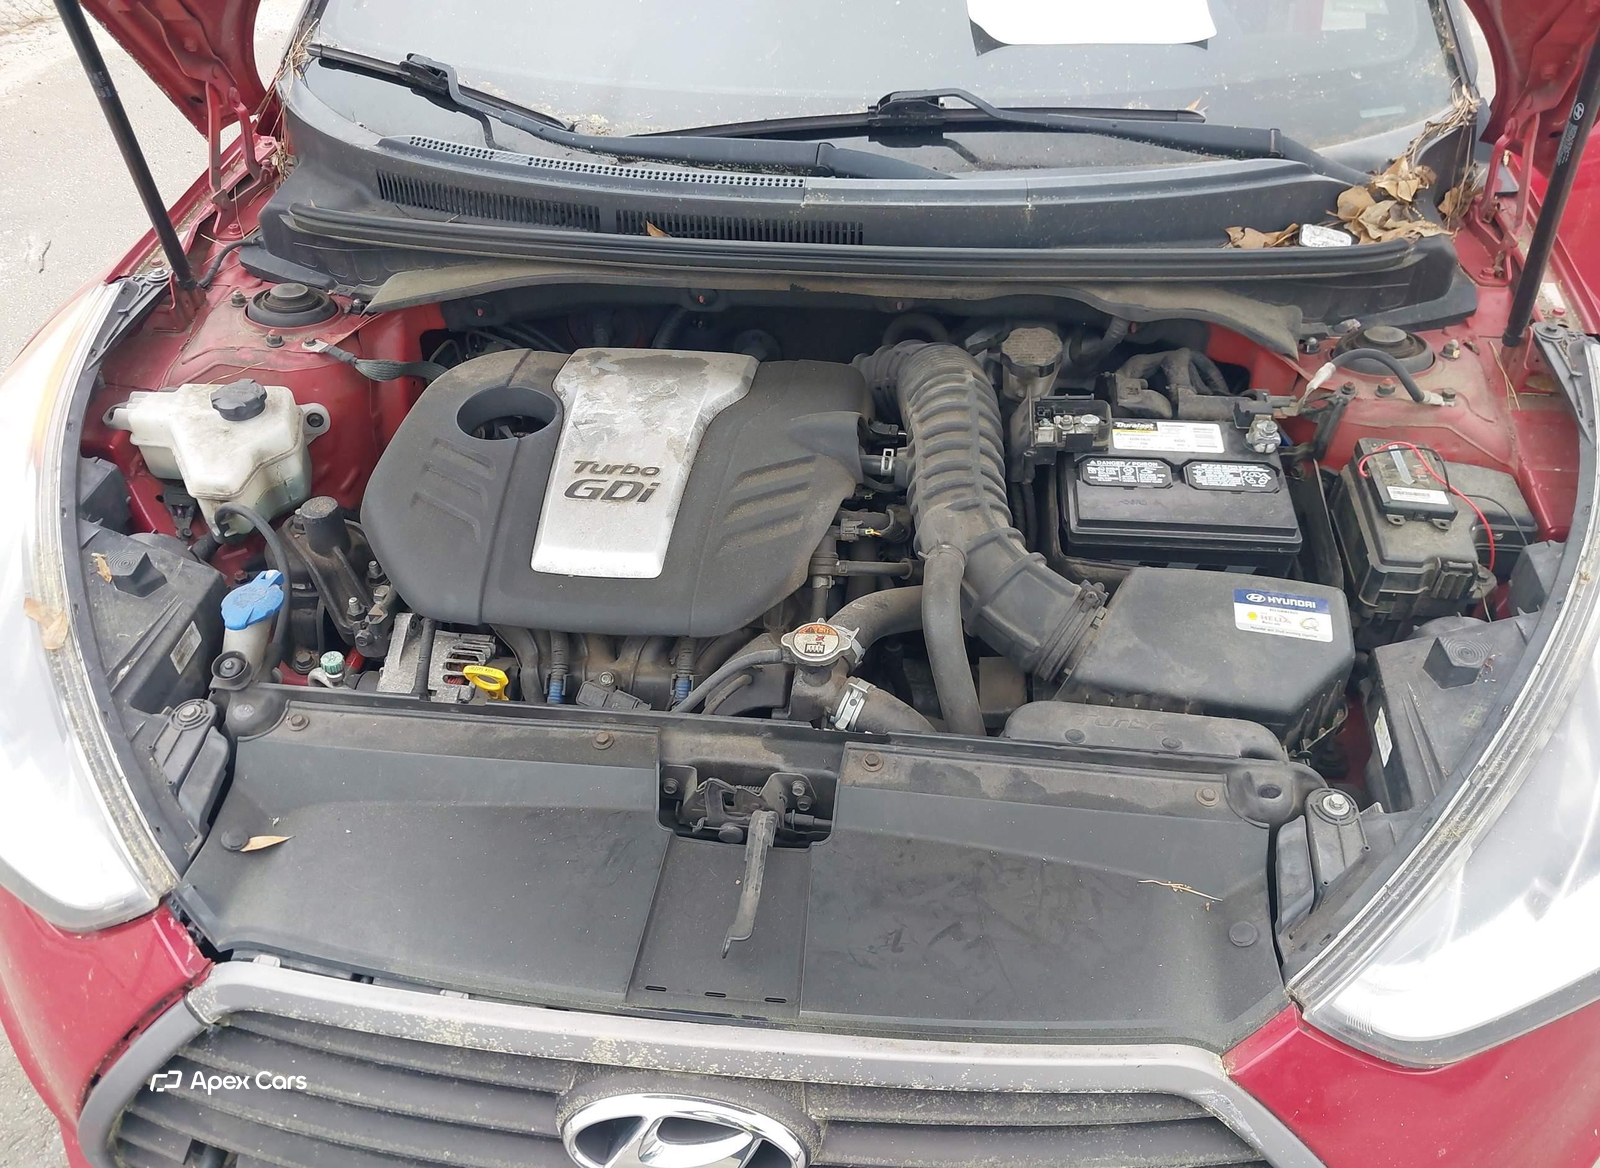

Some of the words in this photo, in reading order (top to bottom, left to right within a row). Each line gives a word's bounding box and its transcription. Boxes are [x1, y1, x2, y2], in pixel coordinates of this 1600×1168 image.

[1114, 421, 1155, 430] Duralast
[574, 460, 661, 476] Turbo
[564, 479, 661, 503] GDi
[1267, 596, 1316, 608] HYUNDAI
